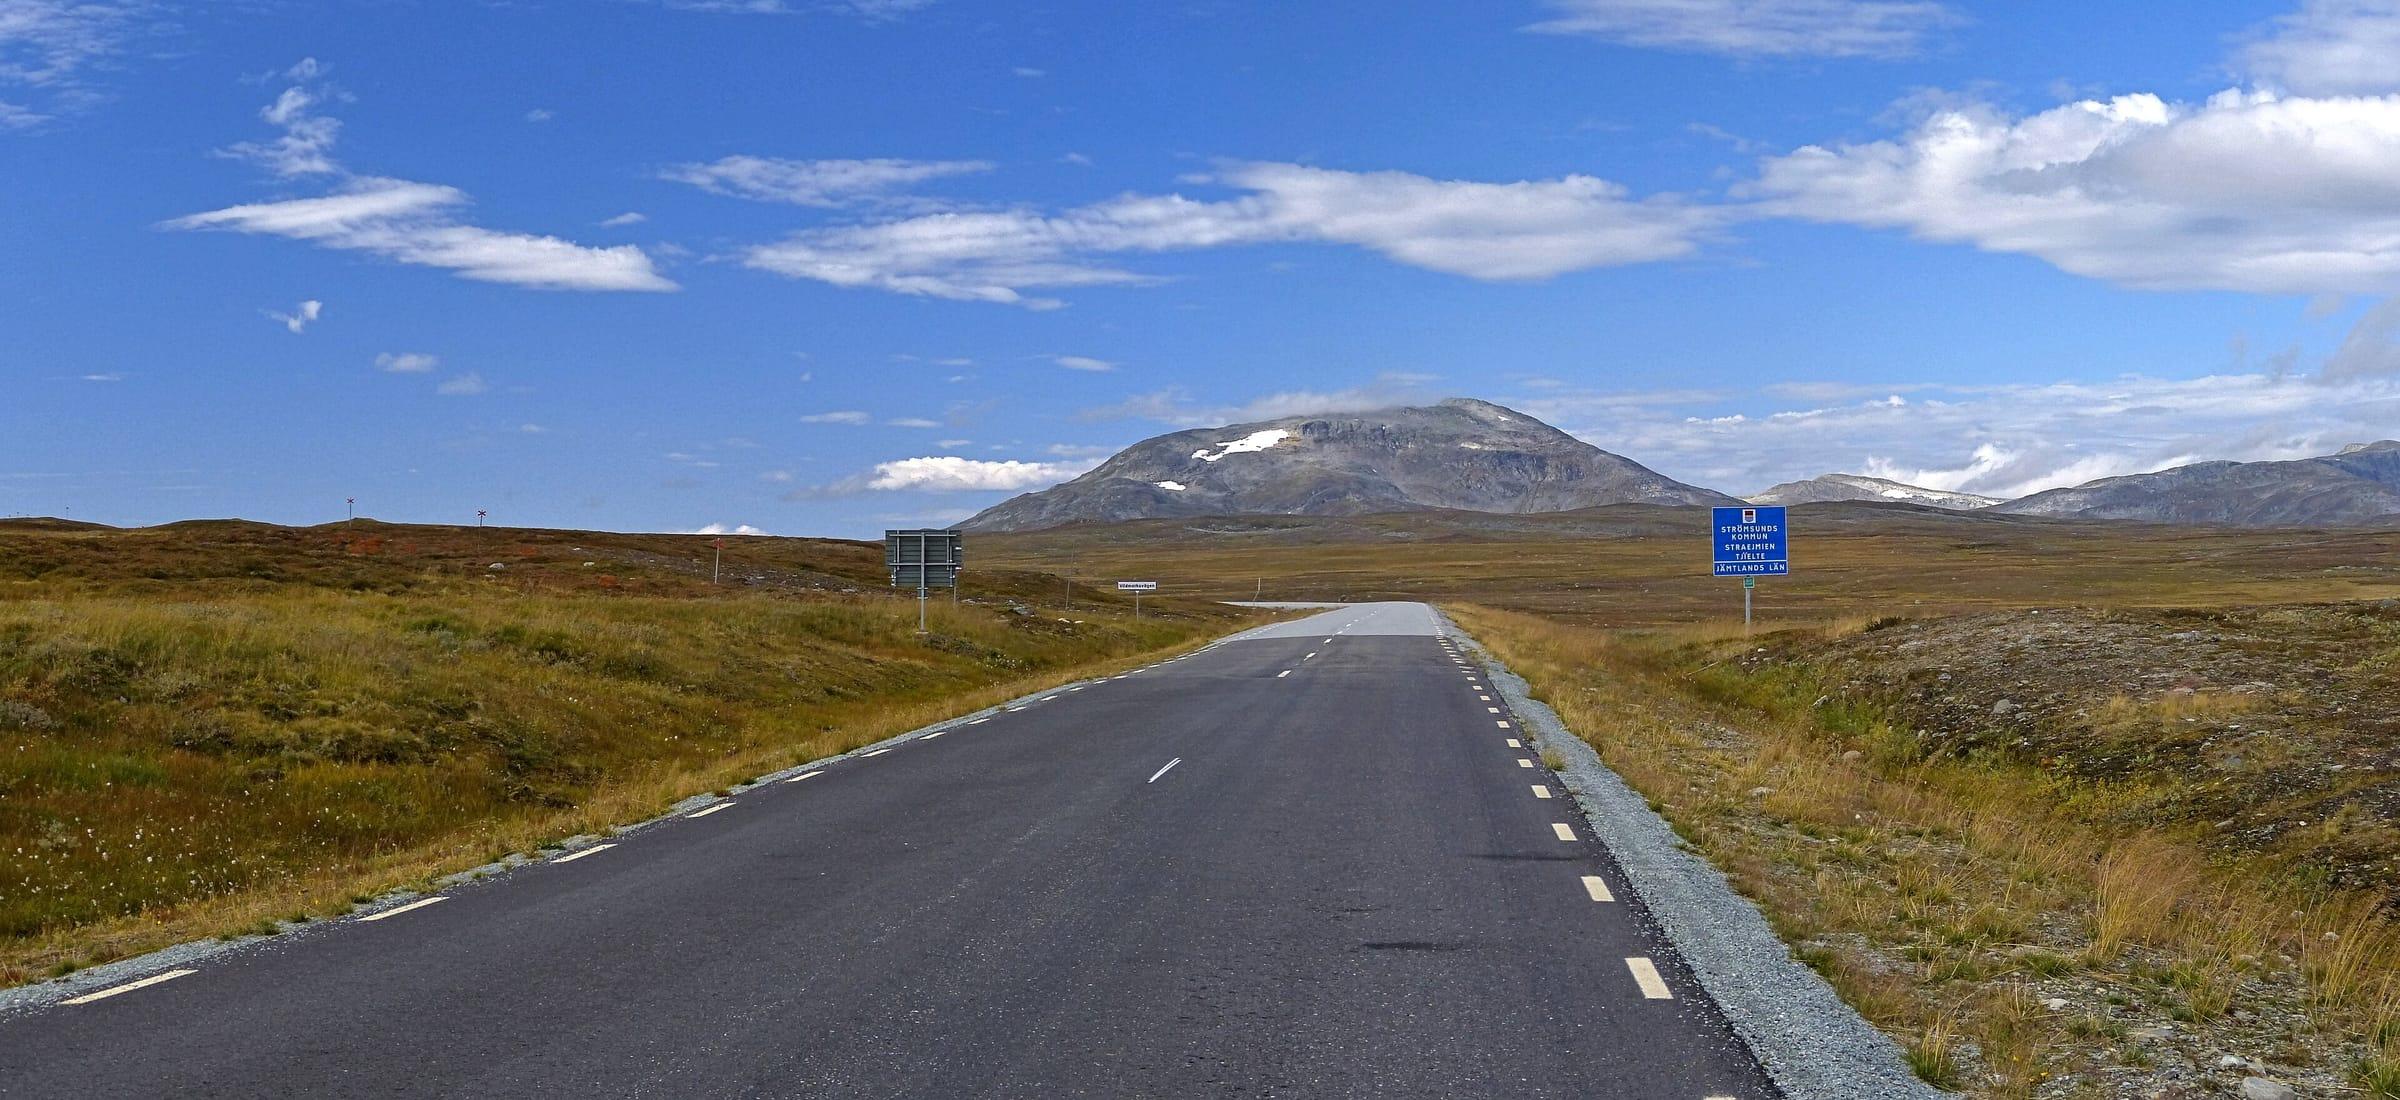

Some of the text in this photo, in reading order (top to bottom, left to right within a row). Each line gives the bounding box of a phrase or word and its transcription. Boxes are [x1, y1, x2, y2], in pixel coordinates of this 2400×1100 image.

[1721, 524, 1778, 533] STRÖMSUNDS
[1725, 543, 1775, 551] STRAEJMIEN
[1716, 562, 1785, 572] JÄMTLANDS LÄN
